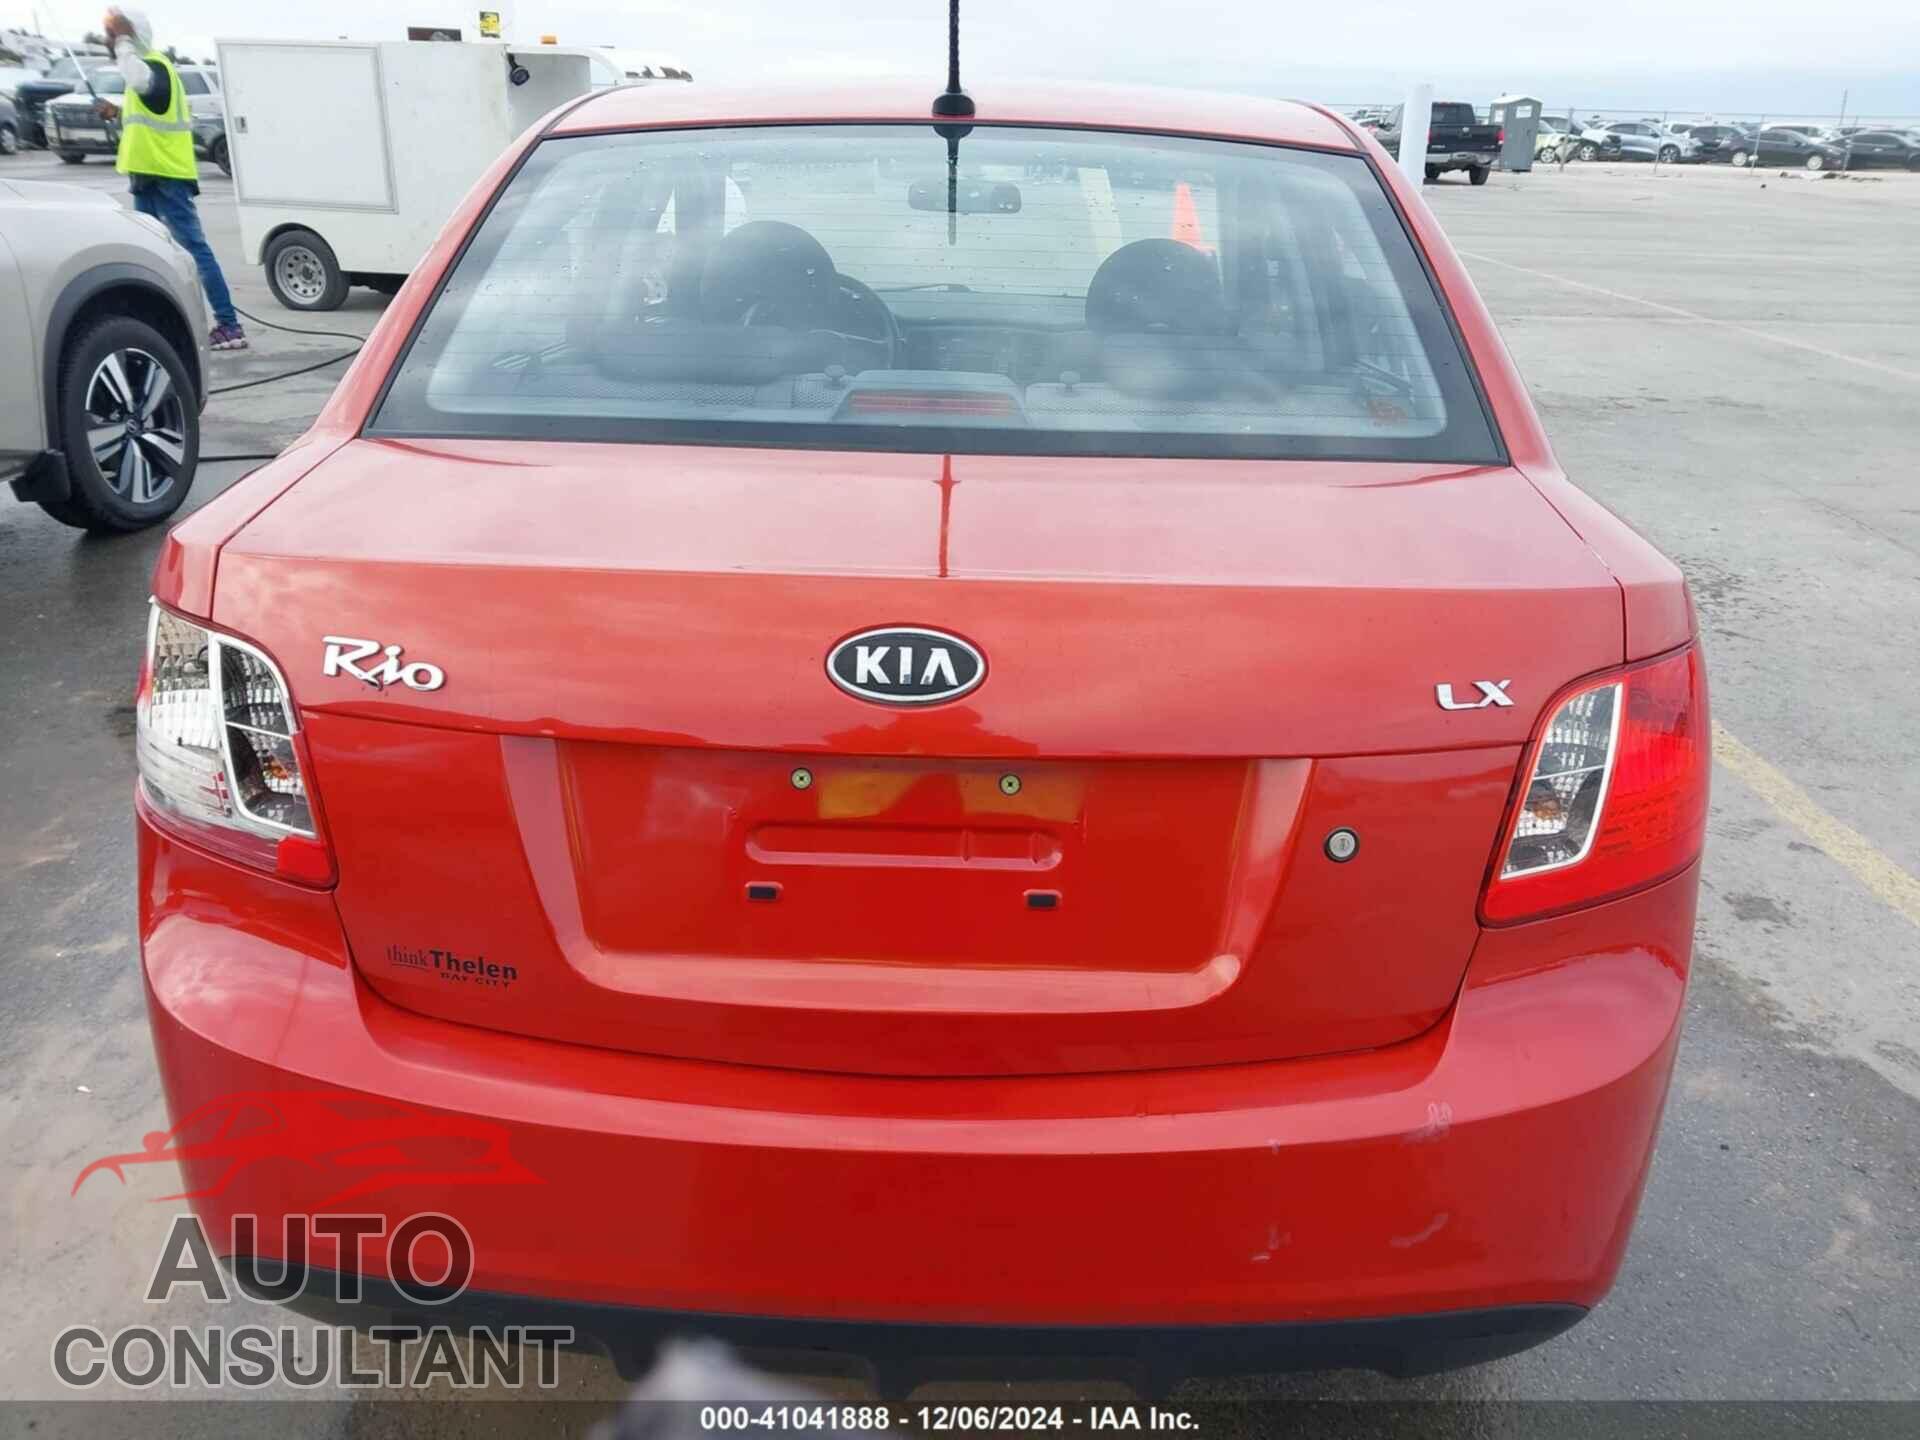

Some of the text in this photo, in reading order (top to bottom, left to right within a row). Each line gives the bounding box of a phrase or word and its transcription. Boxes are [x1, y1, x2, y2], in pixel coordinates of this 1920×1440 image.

[321, 635, 445, 691] Rio
[854, 645, 959, 686] KIA
[1435, 679, 1515, 710] LX
[429, 949, 518, 981] Thelen
